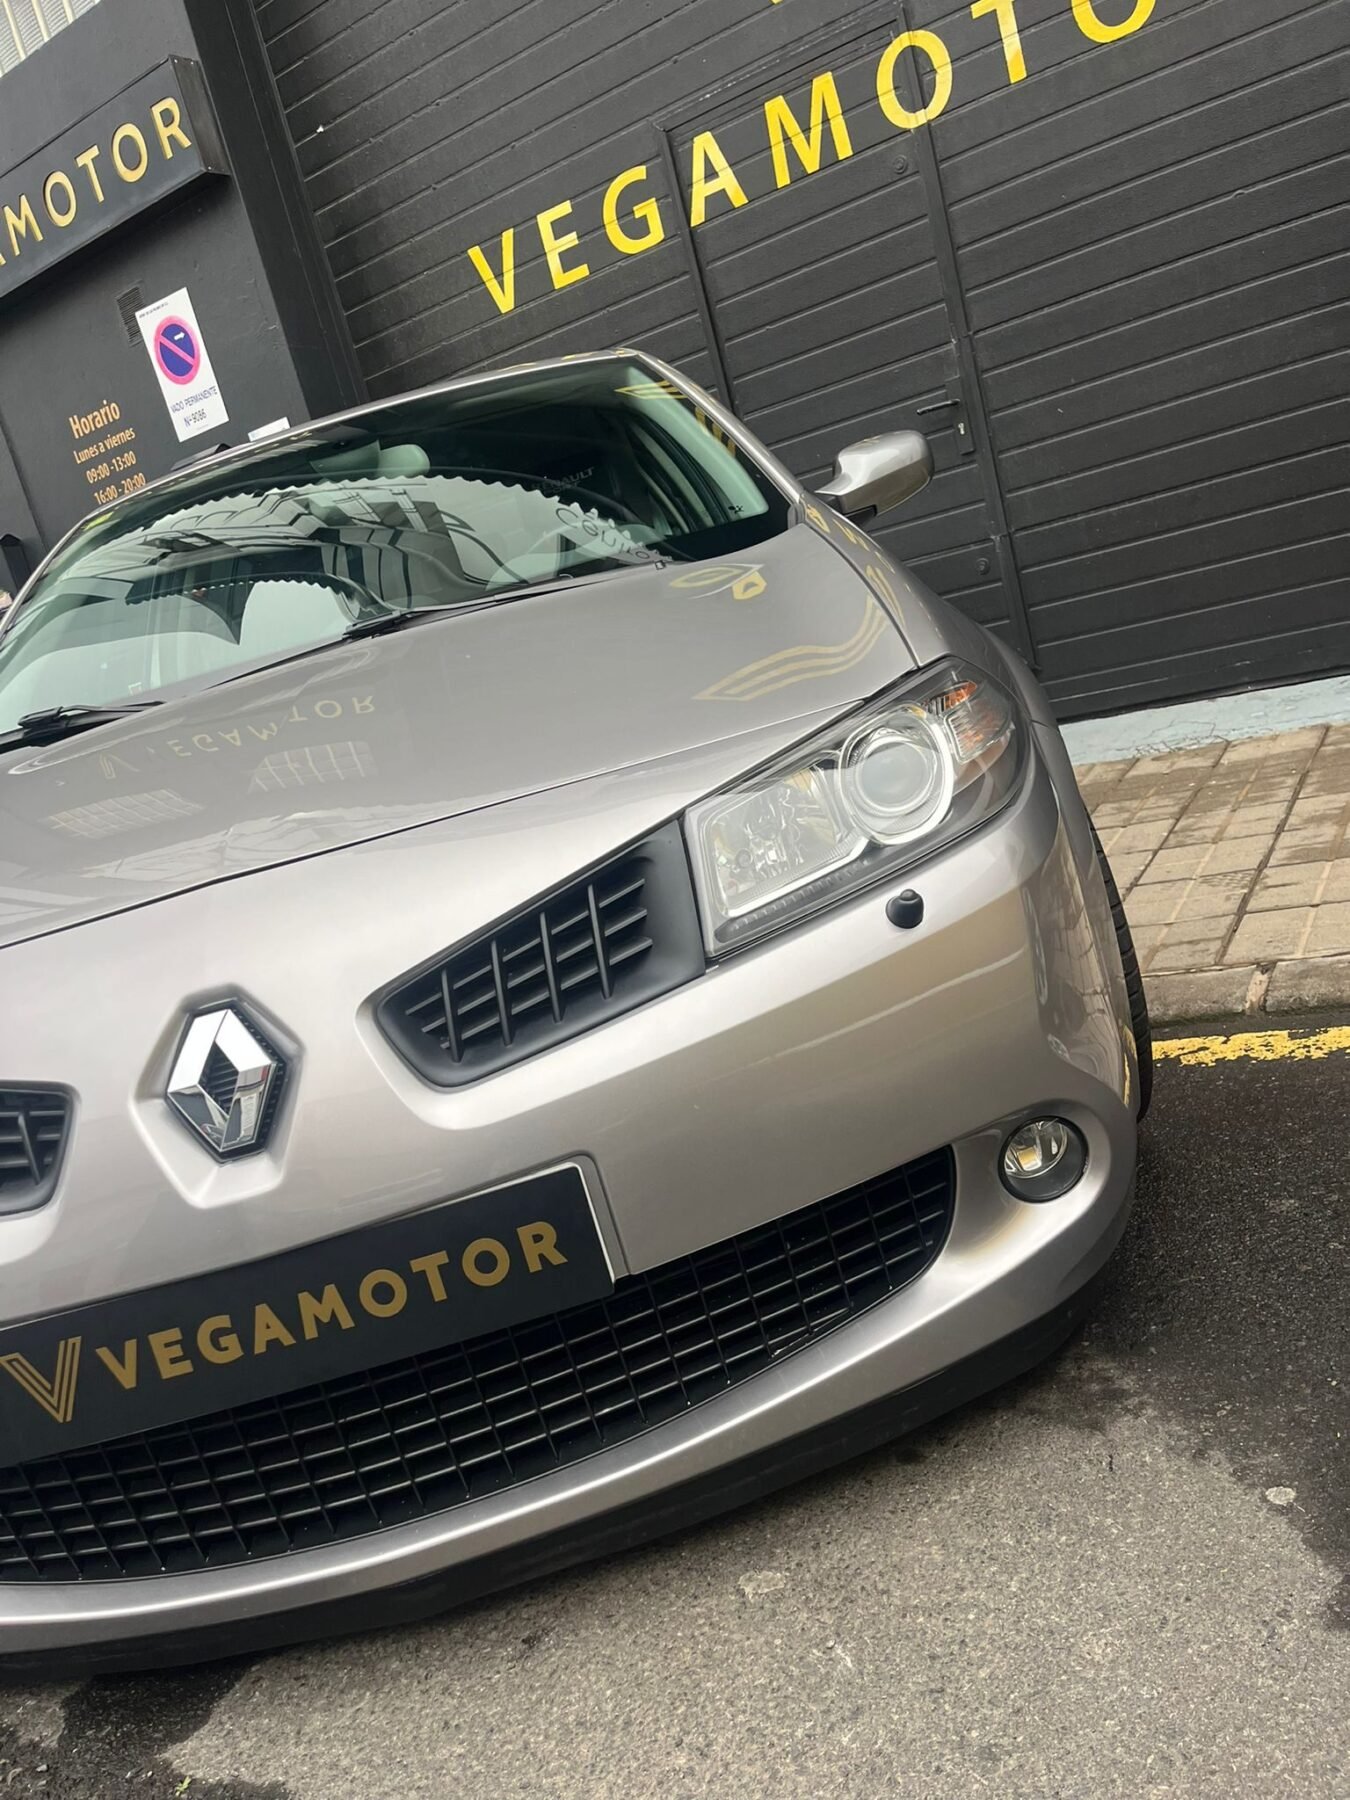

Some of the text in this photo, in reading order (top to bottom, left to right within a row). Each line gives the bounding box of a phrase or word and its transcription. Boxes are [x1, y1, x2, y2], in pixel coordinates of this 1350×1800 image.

[0, 96, 192, 266] MOTOR
[69, 399, 121, 439] Horario
[73, 443, 99, 465] Lunes
[104, 427, 136, 450] viernes
[86, 462, 110, 484] 09:00
[94, 483, 118, 505] 16:00
[122, 472, 146, 495] 20:00
[95, 1221, 569, 1390] VEGAMOTOR
